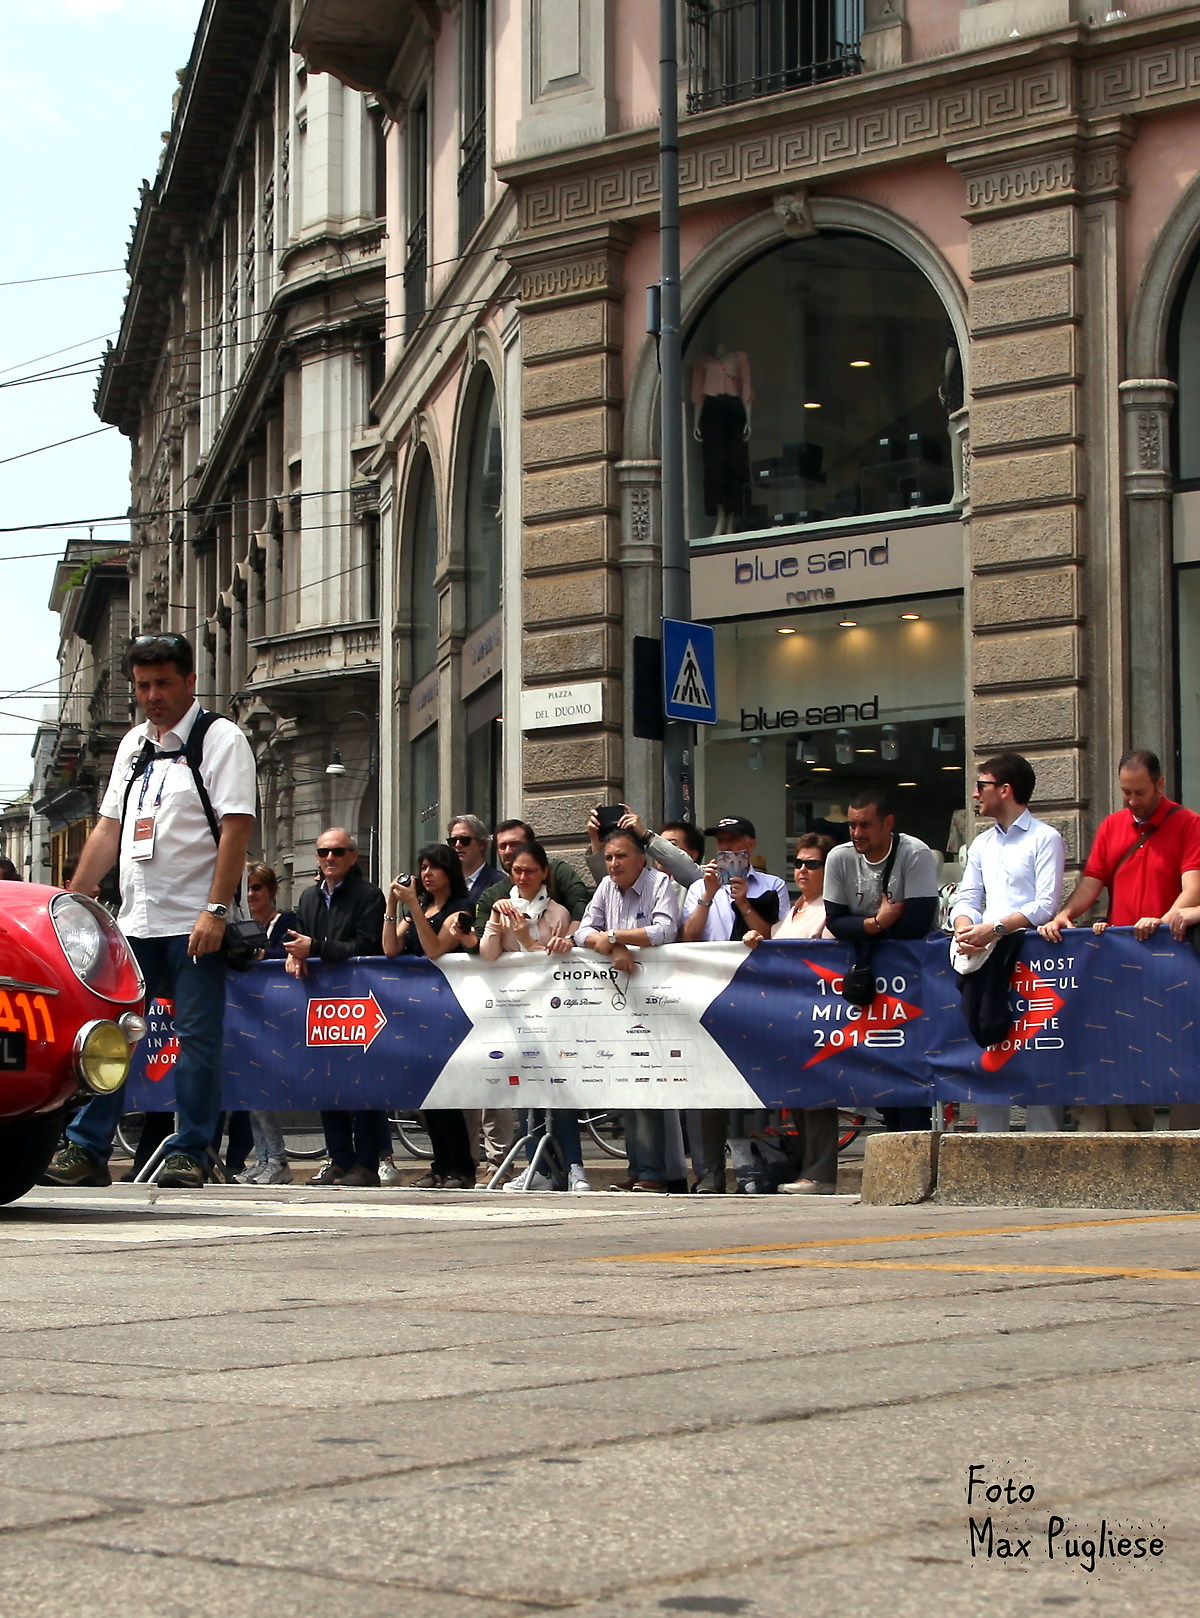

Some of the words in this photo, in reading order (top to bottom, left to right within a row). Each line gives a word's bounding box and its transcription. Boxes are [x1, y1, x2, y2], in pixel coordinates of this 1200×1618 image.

[734, 555, 799, 585] blue
[807, 537, 889, 575] sand
[785, 586, 836, 605] roma
[548, 690, 573, 700] PIAZZA
[535, 709, 549, 719] DEL
[555, 703, 592, 717] DUOMO
[740, 706, 799, 733] blue
[804, 694, 879, 726] sand
[1029, 957, 1075, 972] MOST
[553, 970, 619, 981] CHOPARD
[315, 1003, 366, 1020] 1000
[812, 1002, 908, 1021] MIGLIA
[151, 1021, 176, 1032] RAC
[1013, 1017, 1060, 1031] THE
[311, 1025, 367, 1044] MIGLIA
[813, 1029, 906, 1048] 2018
[147, 1038, 163, 1048] IN
[146, 1053, 177, 1064] WOR
